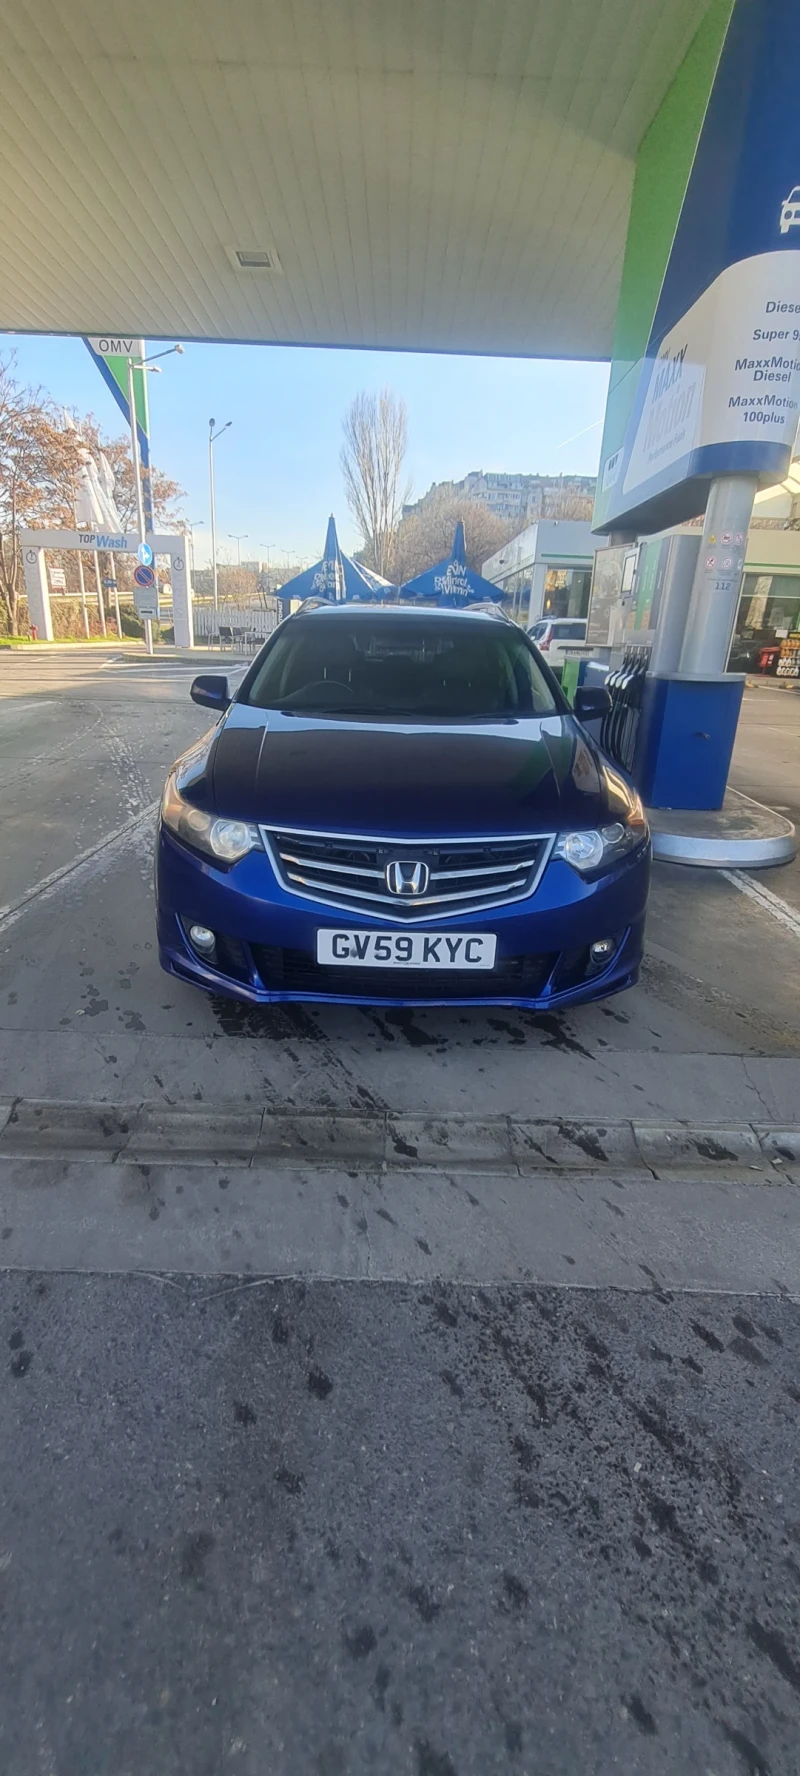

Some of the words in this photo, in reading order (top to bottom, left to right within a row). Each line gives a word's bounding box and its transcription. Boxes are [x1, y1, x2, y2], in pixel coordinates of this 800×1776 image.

[752, 329, 790, 341] Super
[792, 329, 800, 340] 9
[98, 339, 133, 353] OMV
[651, 343, 688, 405] MAXX
[753, 370, 792, 383] Diesel
[728, 394, 799, 409] MaxxMotion
[642, 382, 696, 453] Motion
[742, 411, 785, 424] 100plus
[78, 534, 96, 544] TOP
[96, 535, 128, 549] Wash
[715, 581, 731, 591] 112
[332, 933, 413, 962] GV59
[422, 937, 484, 963] KYC
